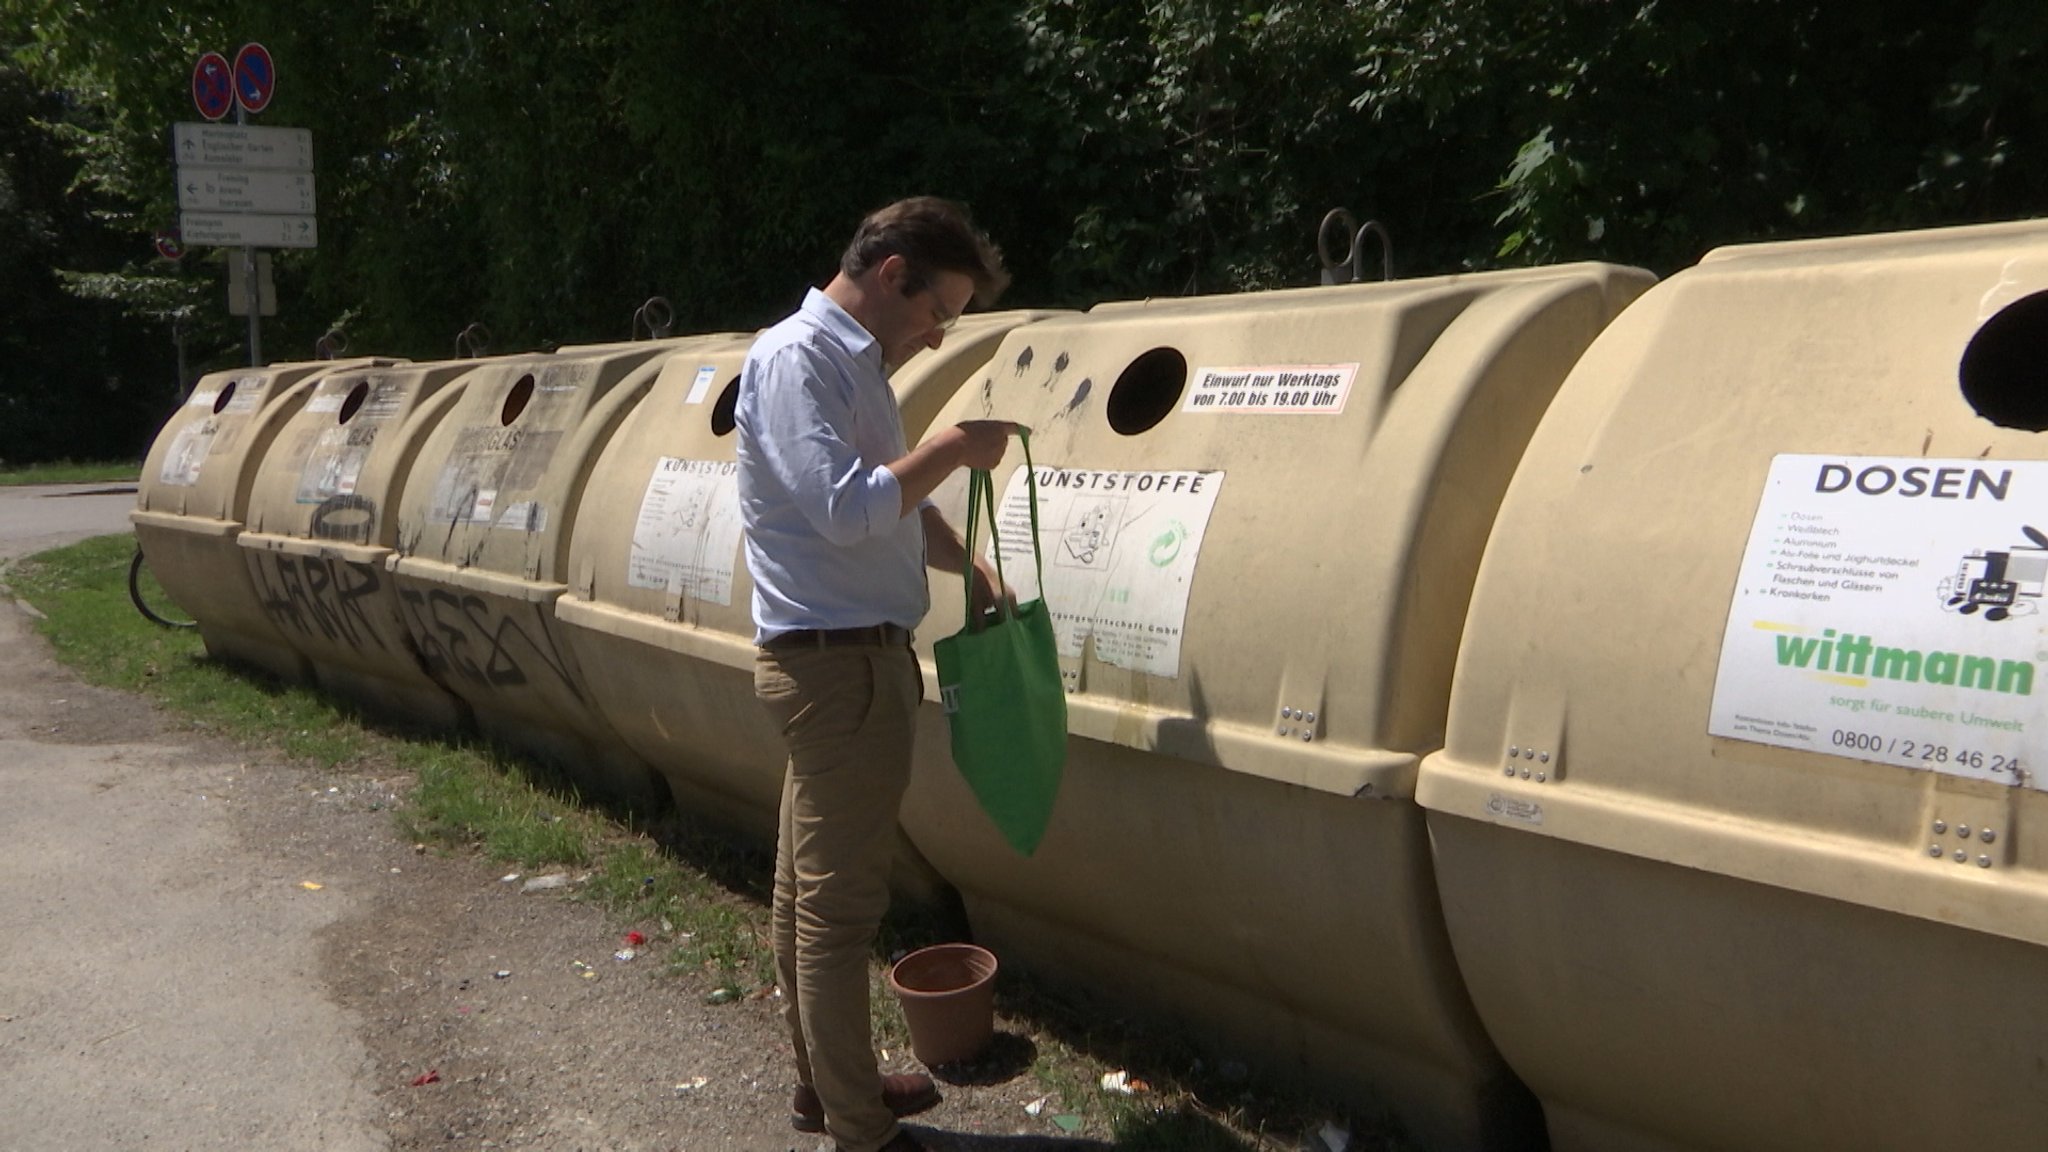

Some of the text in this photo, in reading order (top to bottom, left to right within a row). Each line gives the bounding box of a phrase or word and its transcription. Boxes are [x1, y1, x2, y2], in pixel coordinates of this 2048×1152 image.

[1202, 373, 1341, 389] Einwurf nur Werktags
[1193, 390, 1338, 406] von 7.00 bis 19.00 Uhr
[487, 430, 521, 450] GLAS
[1815, 463, 2012, 500] DOSEN
[1791, 511, 1823, 521] Dosen
[1788, 524, 1839, 536] Weißblech
[1783, 537, 1837, 549] Aluminium
[1822, 553, 1841, 561] und
[1773, 573, 1883, 592] Flaschen und Gläsern
[1879, 571, 1899, 580] von
[1769, 587, 1831, 602] Kronkorken
[1776, 628, 2036, 696] wittmann
[1829, 695, 2025, 733] sorgt für saubere Umwelt
[1832, 729, 1882, 752] 0800
[1901, 740, 1916, 758] 2
[1922, 744, 1949, 763] 28
[1955, 750, 1984, 769] 46
[1990, 755, 2019, 773] 24
